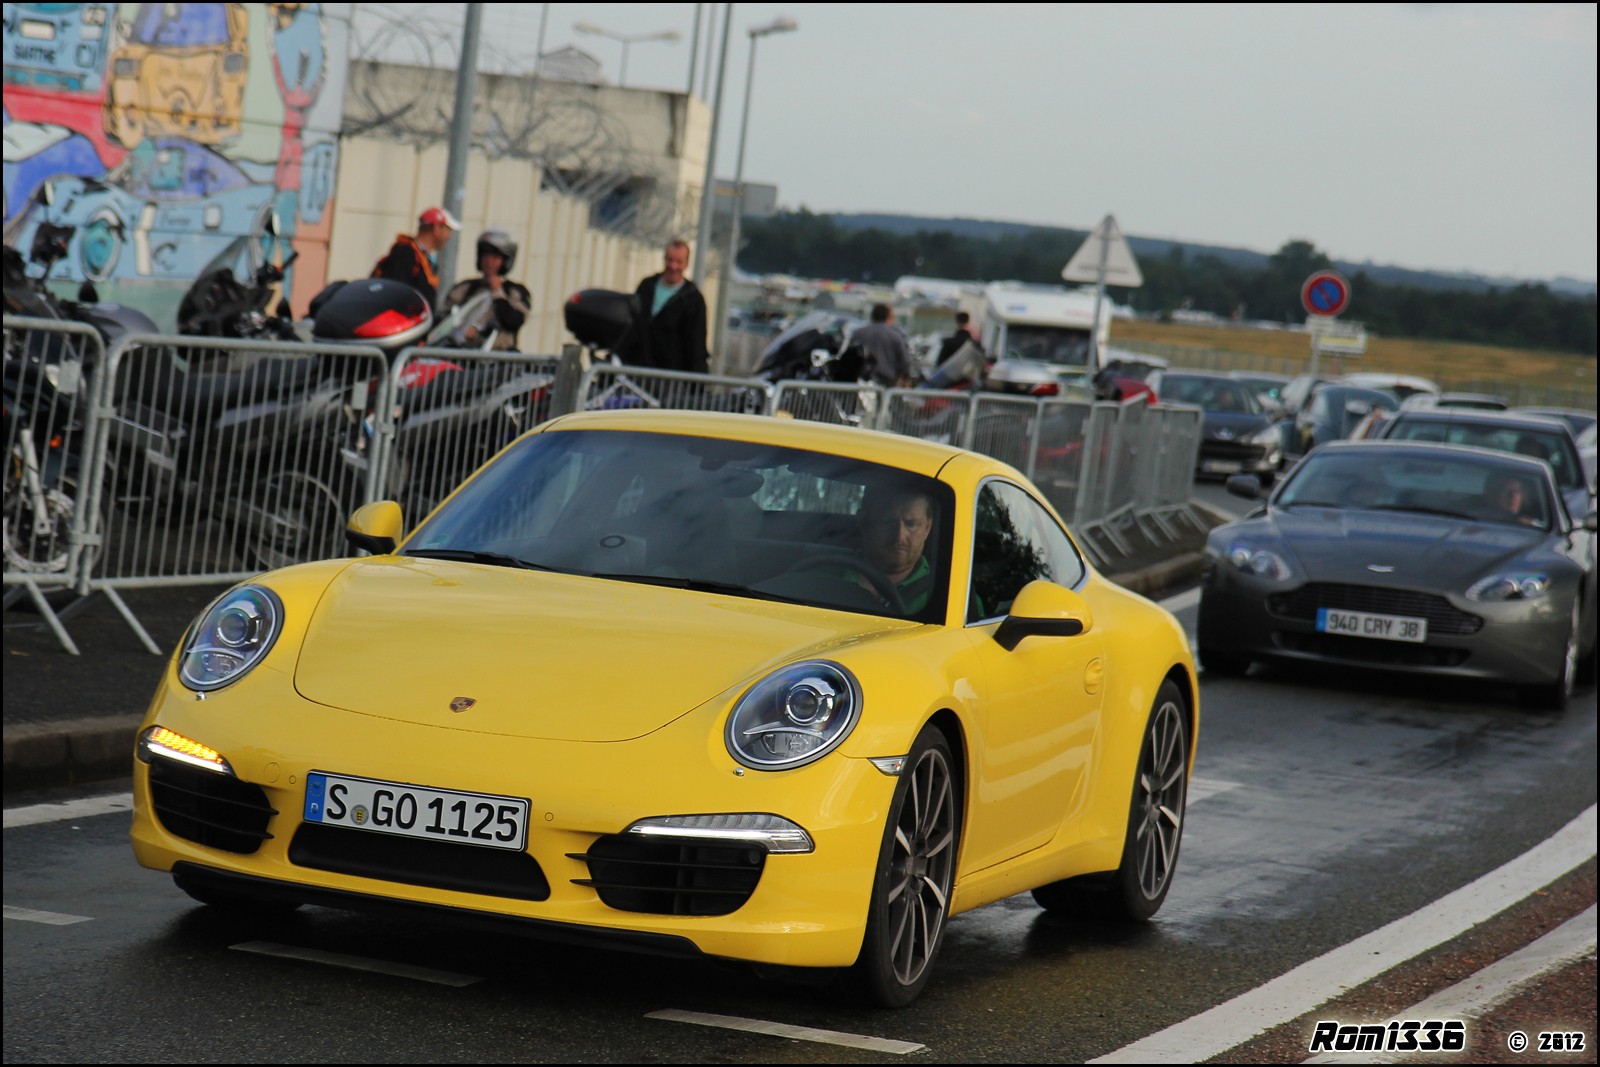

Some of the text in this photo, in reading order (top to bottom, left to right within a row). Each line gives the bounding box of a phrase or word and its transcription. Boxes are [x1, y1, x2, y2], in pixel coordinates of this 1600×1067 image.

[1329, 613, 1359, 632] 940
[326, 783, 520, 842] S GO 1125
